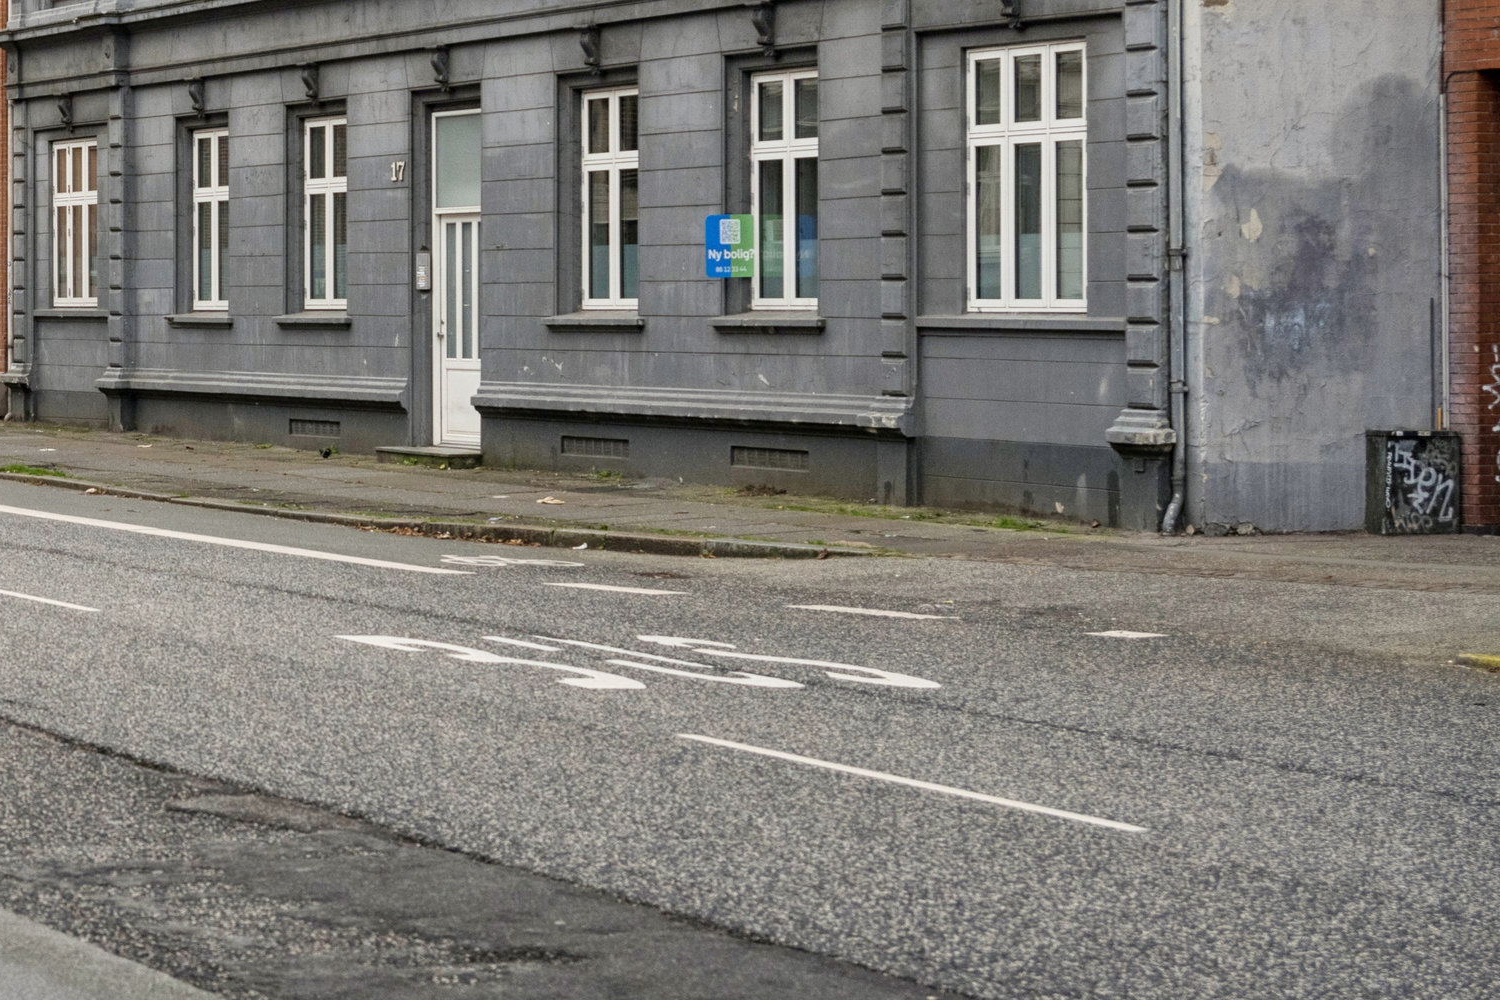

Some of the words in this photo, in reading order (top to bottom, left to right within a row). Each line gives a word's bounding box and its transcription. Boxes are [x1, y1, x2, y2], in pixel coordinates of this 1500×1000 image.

[391, 161, 405, 181] 17
[708, 249, 722, 261] Ny
[724, 248, 755, 261] bolig?
